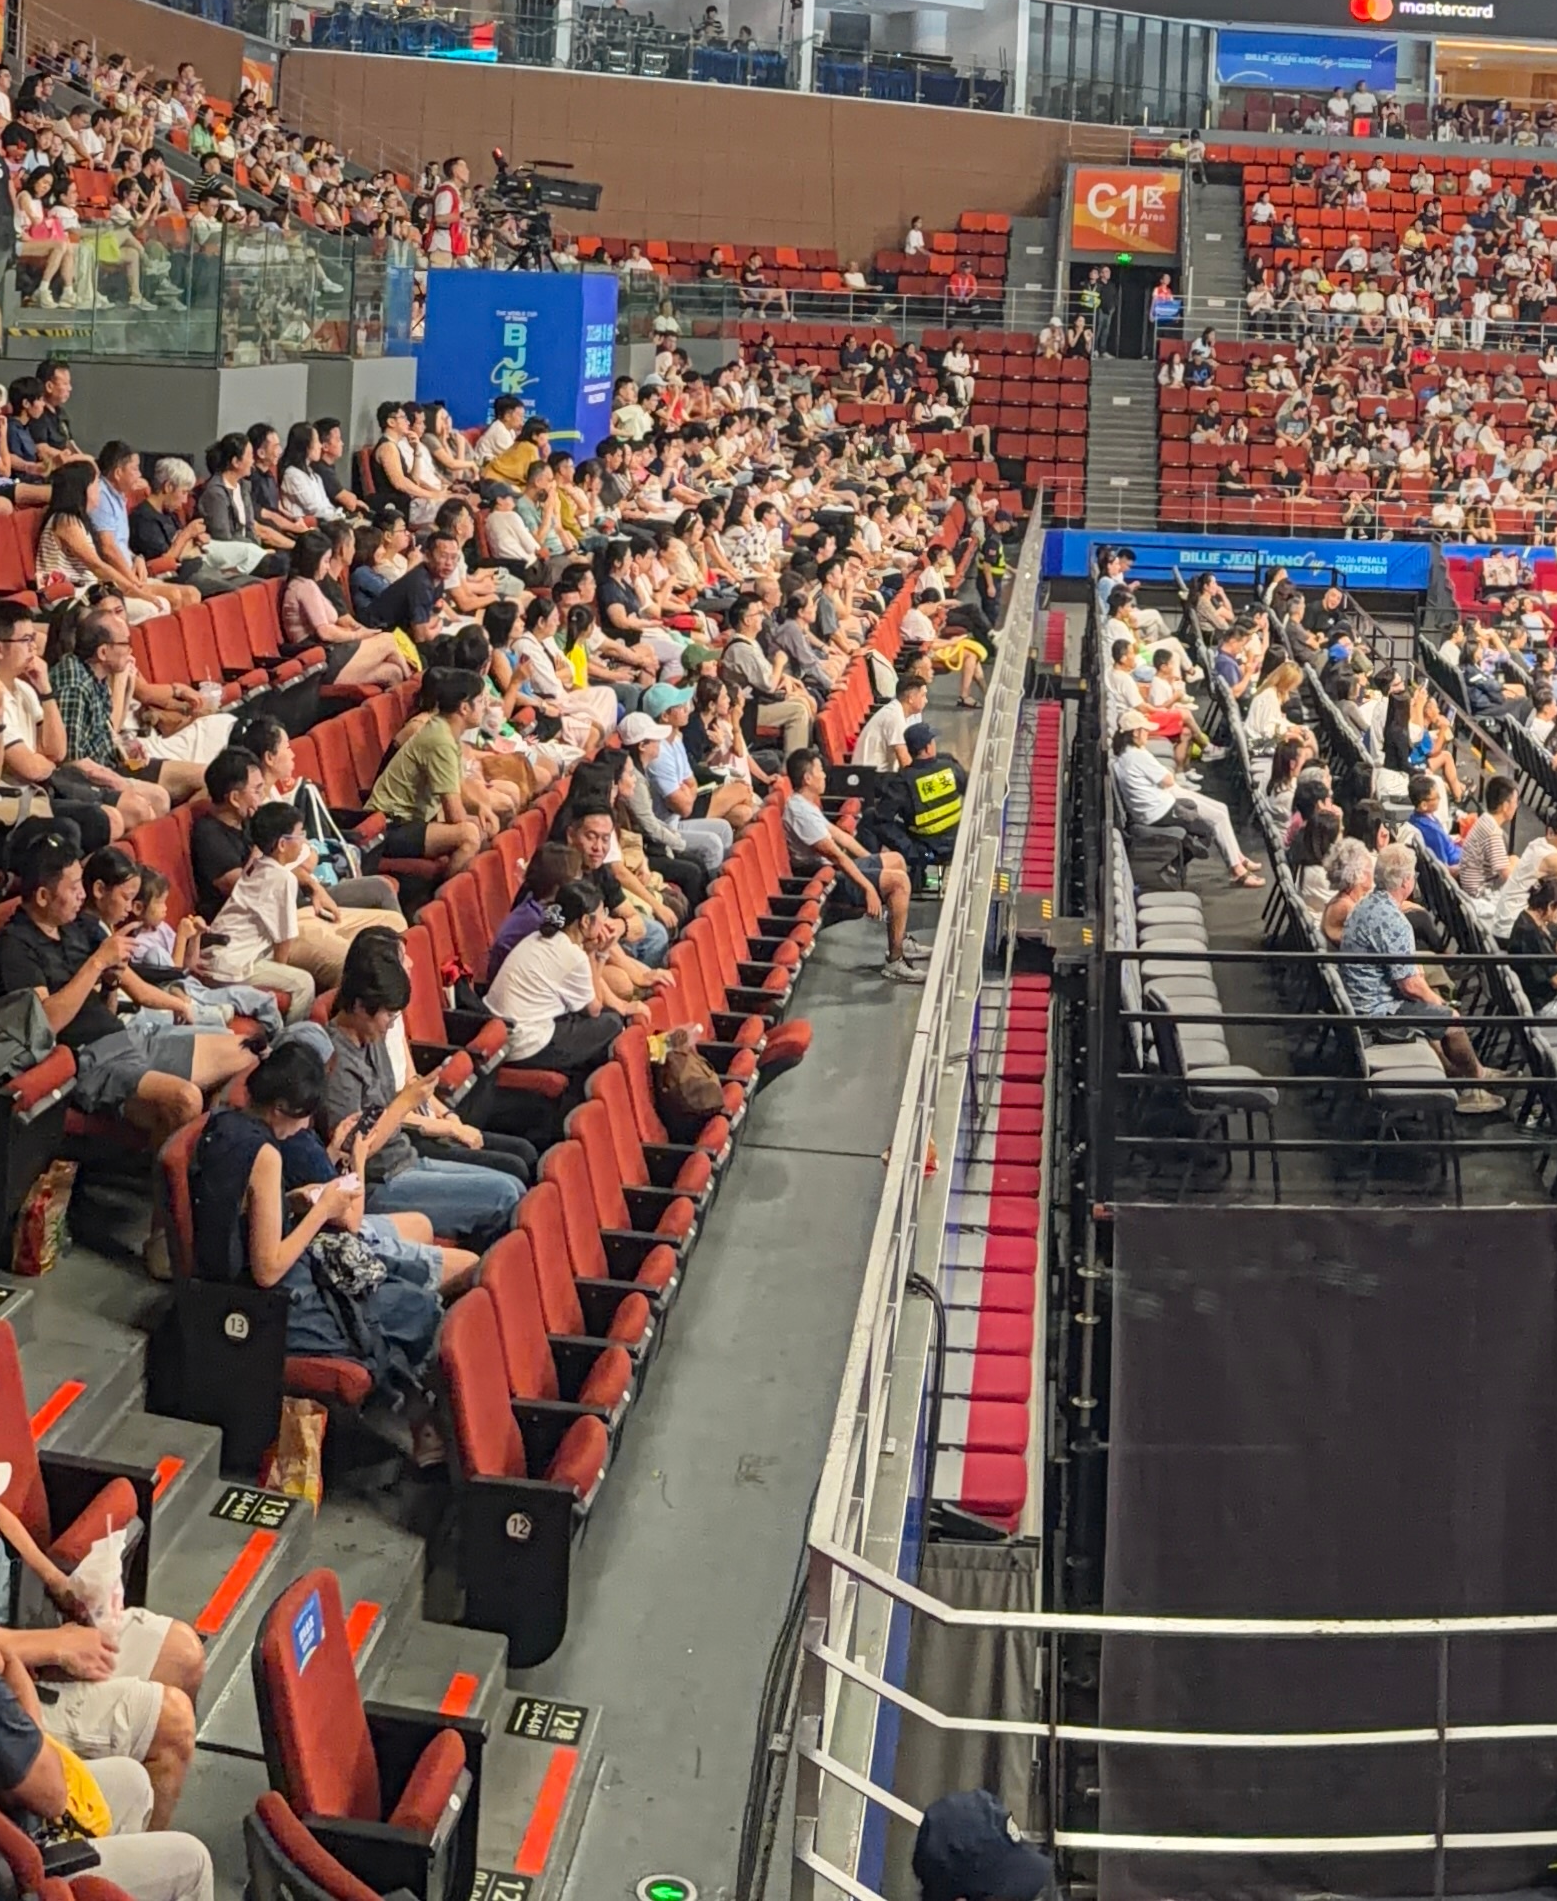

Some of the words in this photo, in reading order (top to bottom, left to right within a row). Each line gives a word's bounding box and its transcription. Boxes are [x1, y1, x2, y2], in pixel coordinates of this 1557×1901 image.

[1399, 1, 1494, 19] mastercard
[1087, 183, 1166, 220] C1区
[1179, 550, 1221, 564] BILLIE
[1357, 555, 1388, 565] FINALS
[230, 1317, 244, 1333] 13
[510, 1517, 528, 1536] 12
